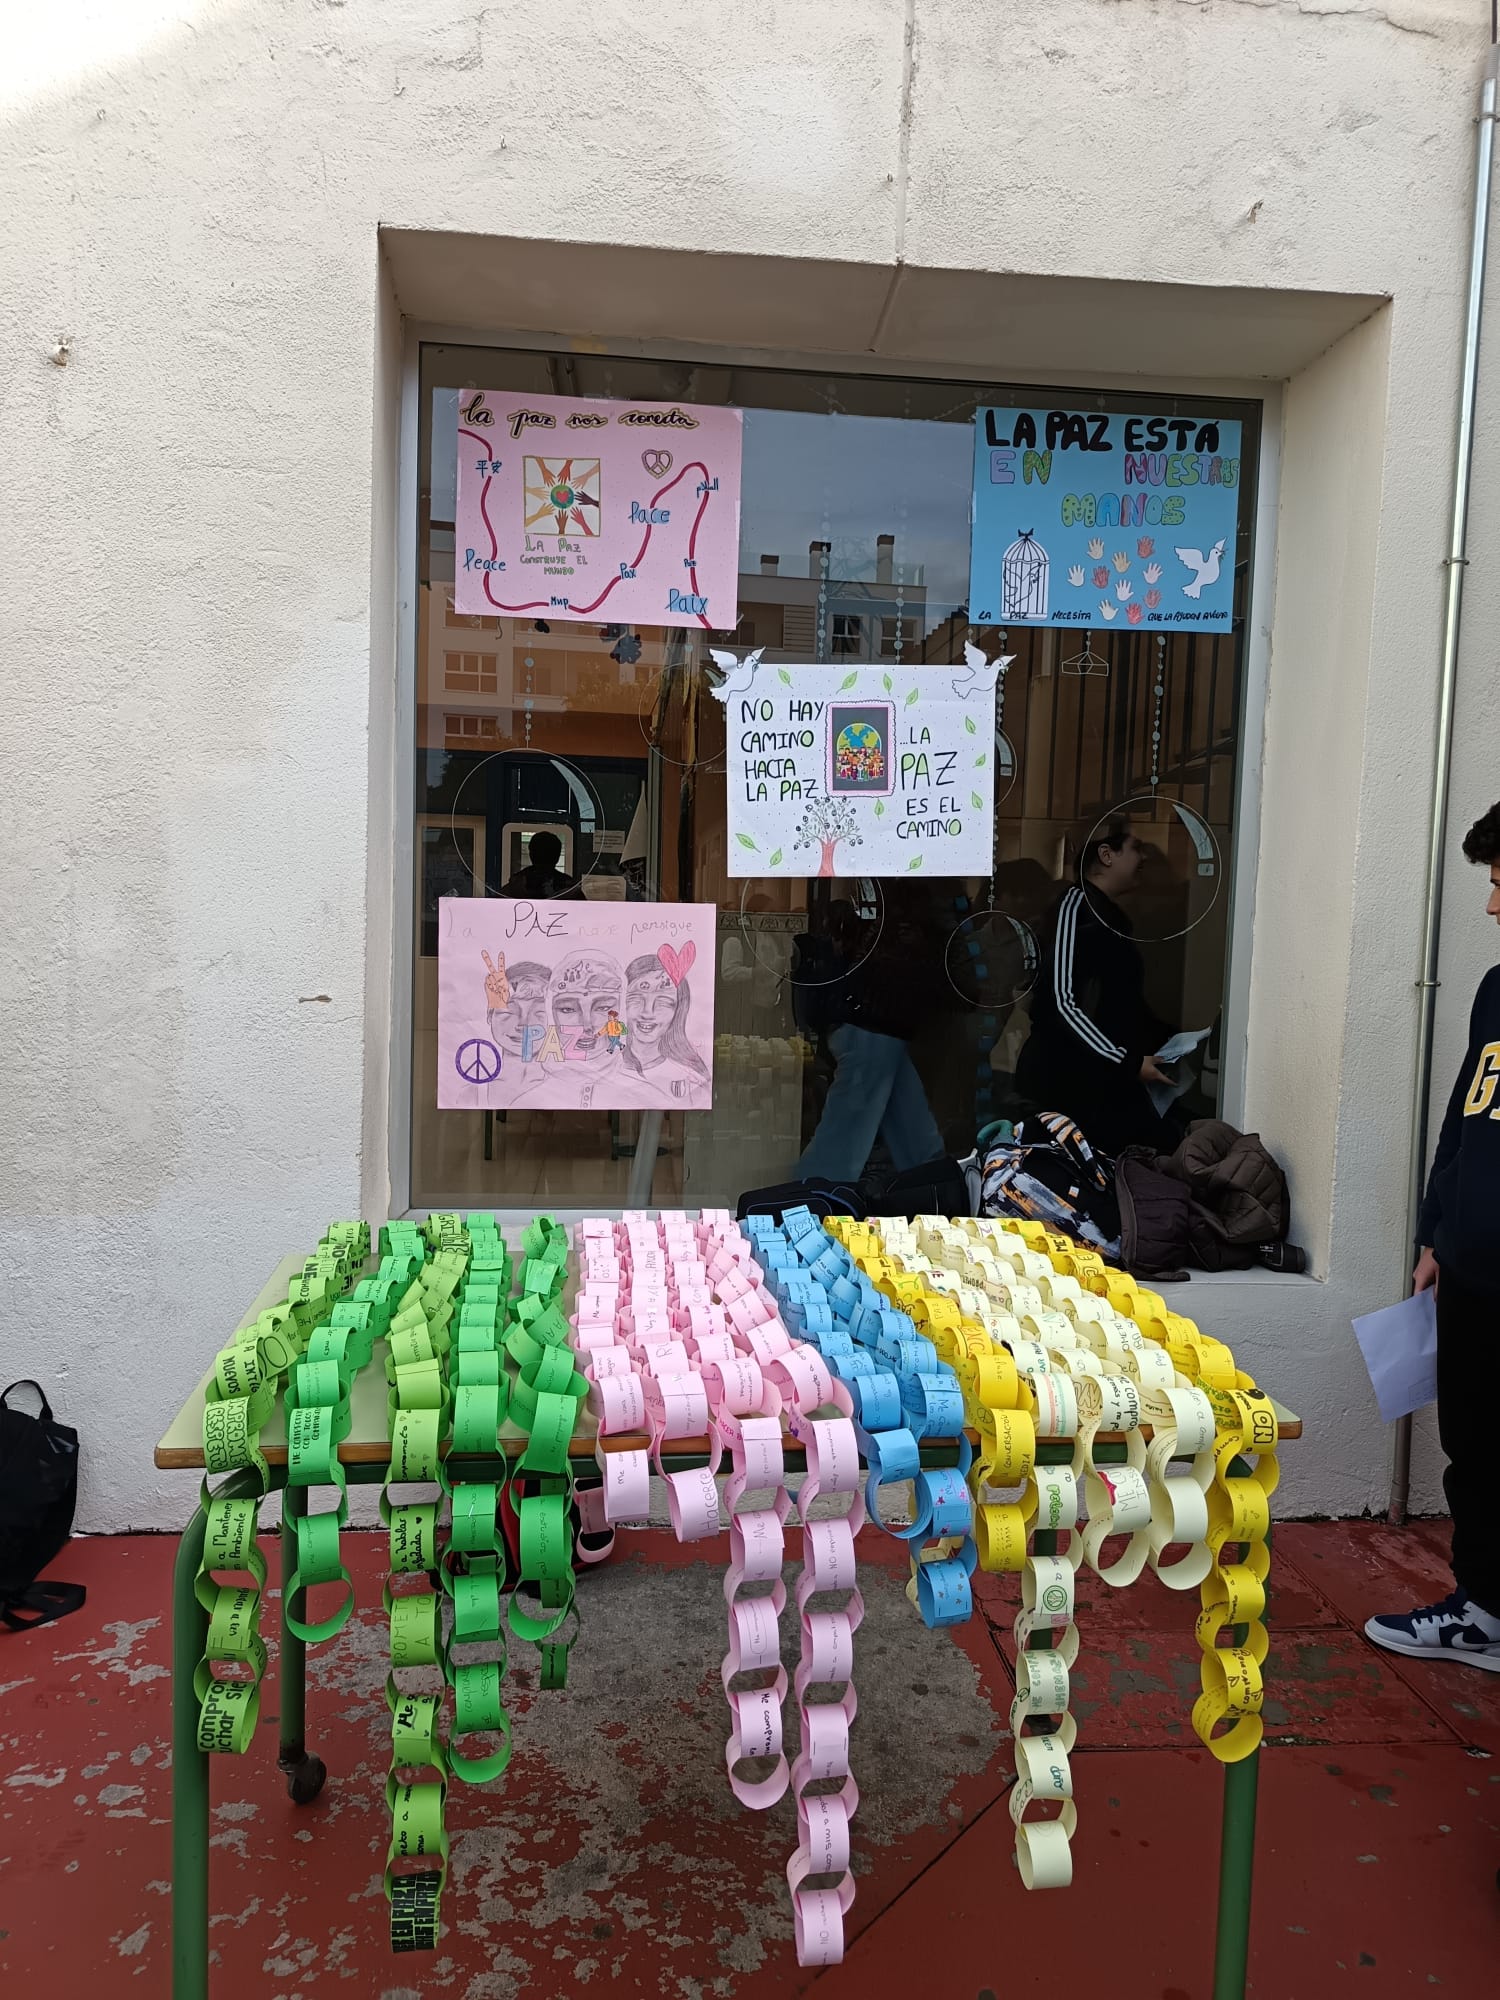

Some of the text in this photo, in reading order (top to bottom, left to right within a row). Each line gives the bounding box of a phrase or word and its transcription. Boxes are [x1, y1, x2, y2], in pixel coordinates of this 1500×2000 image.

[460, 392, 494, 426] la
[508, 409, 556, 439] paz
[566, 411, 608, 429] nos
[985, 409, 1036, 449] LA
[1045, 411, 1113, 452] PAZ
[990, 450, 1239, 488] EN NUESTRAS
[629, 501, 670, 525] Pace
[1061, 492, 1187, 528] MANOS
[525, 535, 544, 553] LA
[463, 548, 506, 573] Peace
[577, 556, 588, 566] EL
[619, 562, 637, 580] Pax
[664, 588, 709, 616] Paix
[978, 610, 992, 620] LA
[1009, 610, 1029, 620] PAZ
[741, 699, 825, 724] NO HAY
[741, 730, 815, 753] CAMINO
[744, 758, 796, 780] HACIA
[900, 751, 958, 791] PAZ
[746, 780, 768, 802] LA
[906, 797, 961, 816] ES EL
[896, 818, 962, 840] CAMINO
[505, 901, 569, 939] PAZ
[519, 1025, 588, 1064] PAZ
